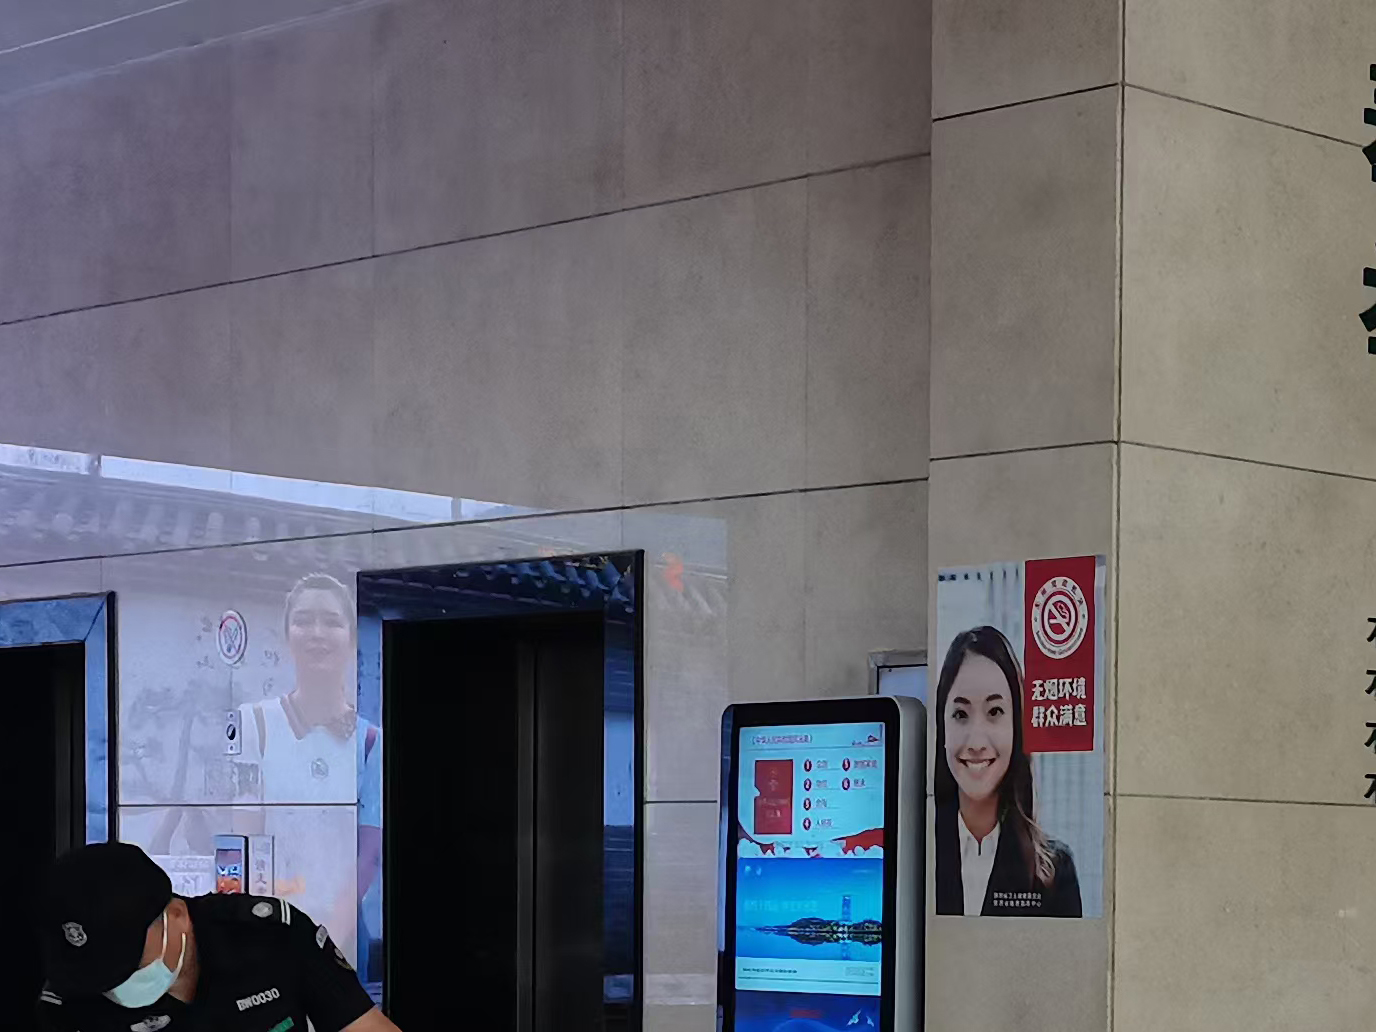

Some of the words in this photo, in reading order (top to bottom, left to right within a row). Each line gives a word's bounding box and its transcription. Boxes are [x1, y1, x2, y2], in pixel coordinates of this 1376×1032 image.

[1031, 677, 1086, 701] 无烟环境
[1031, 704, 1087, 727] 群众满意
